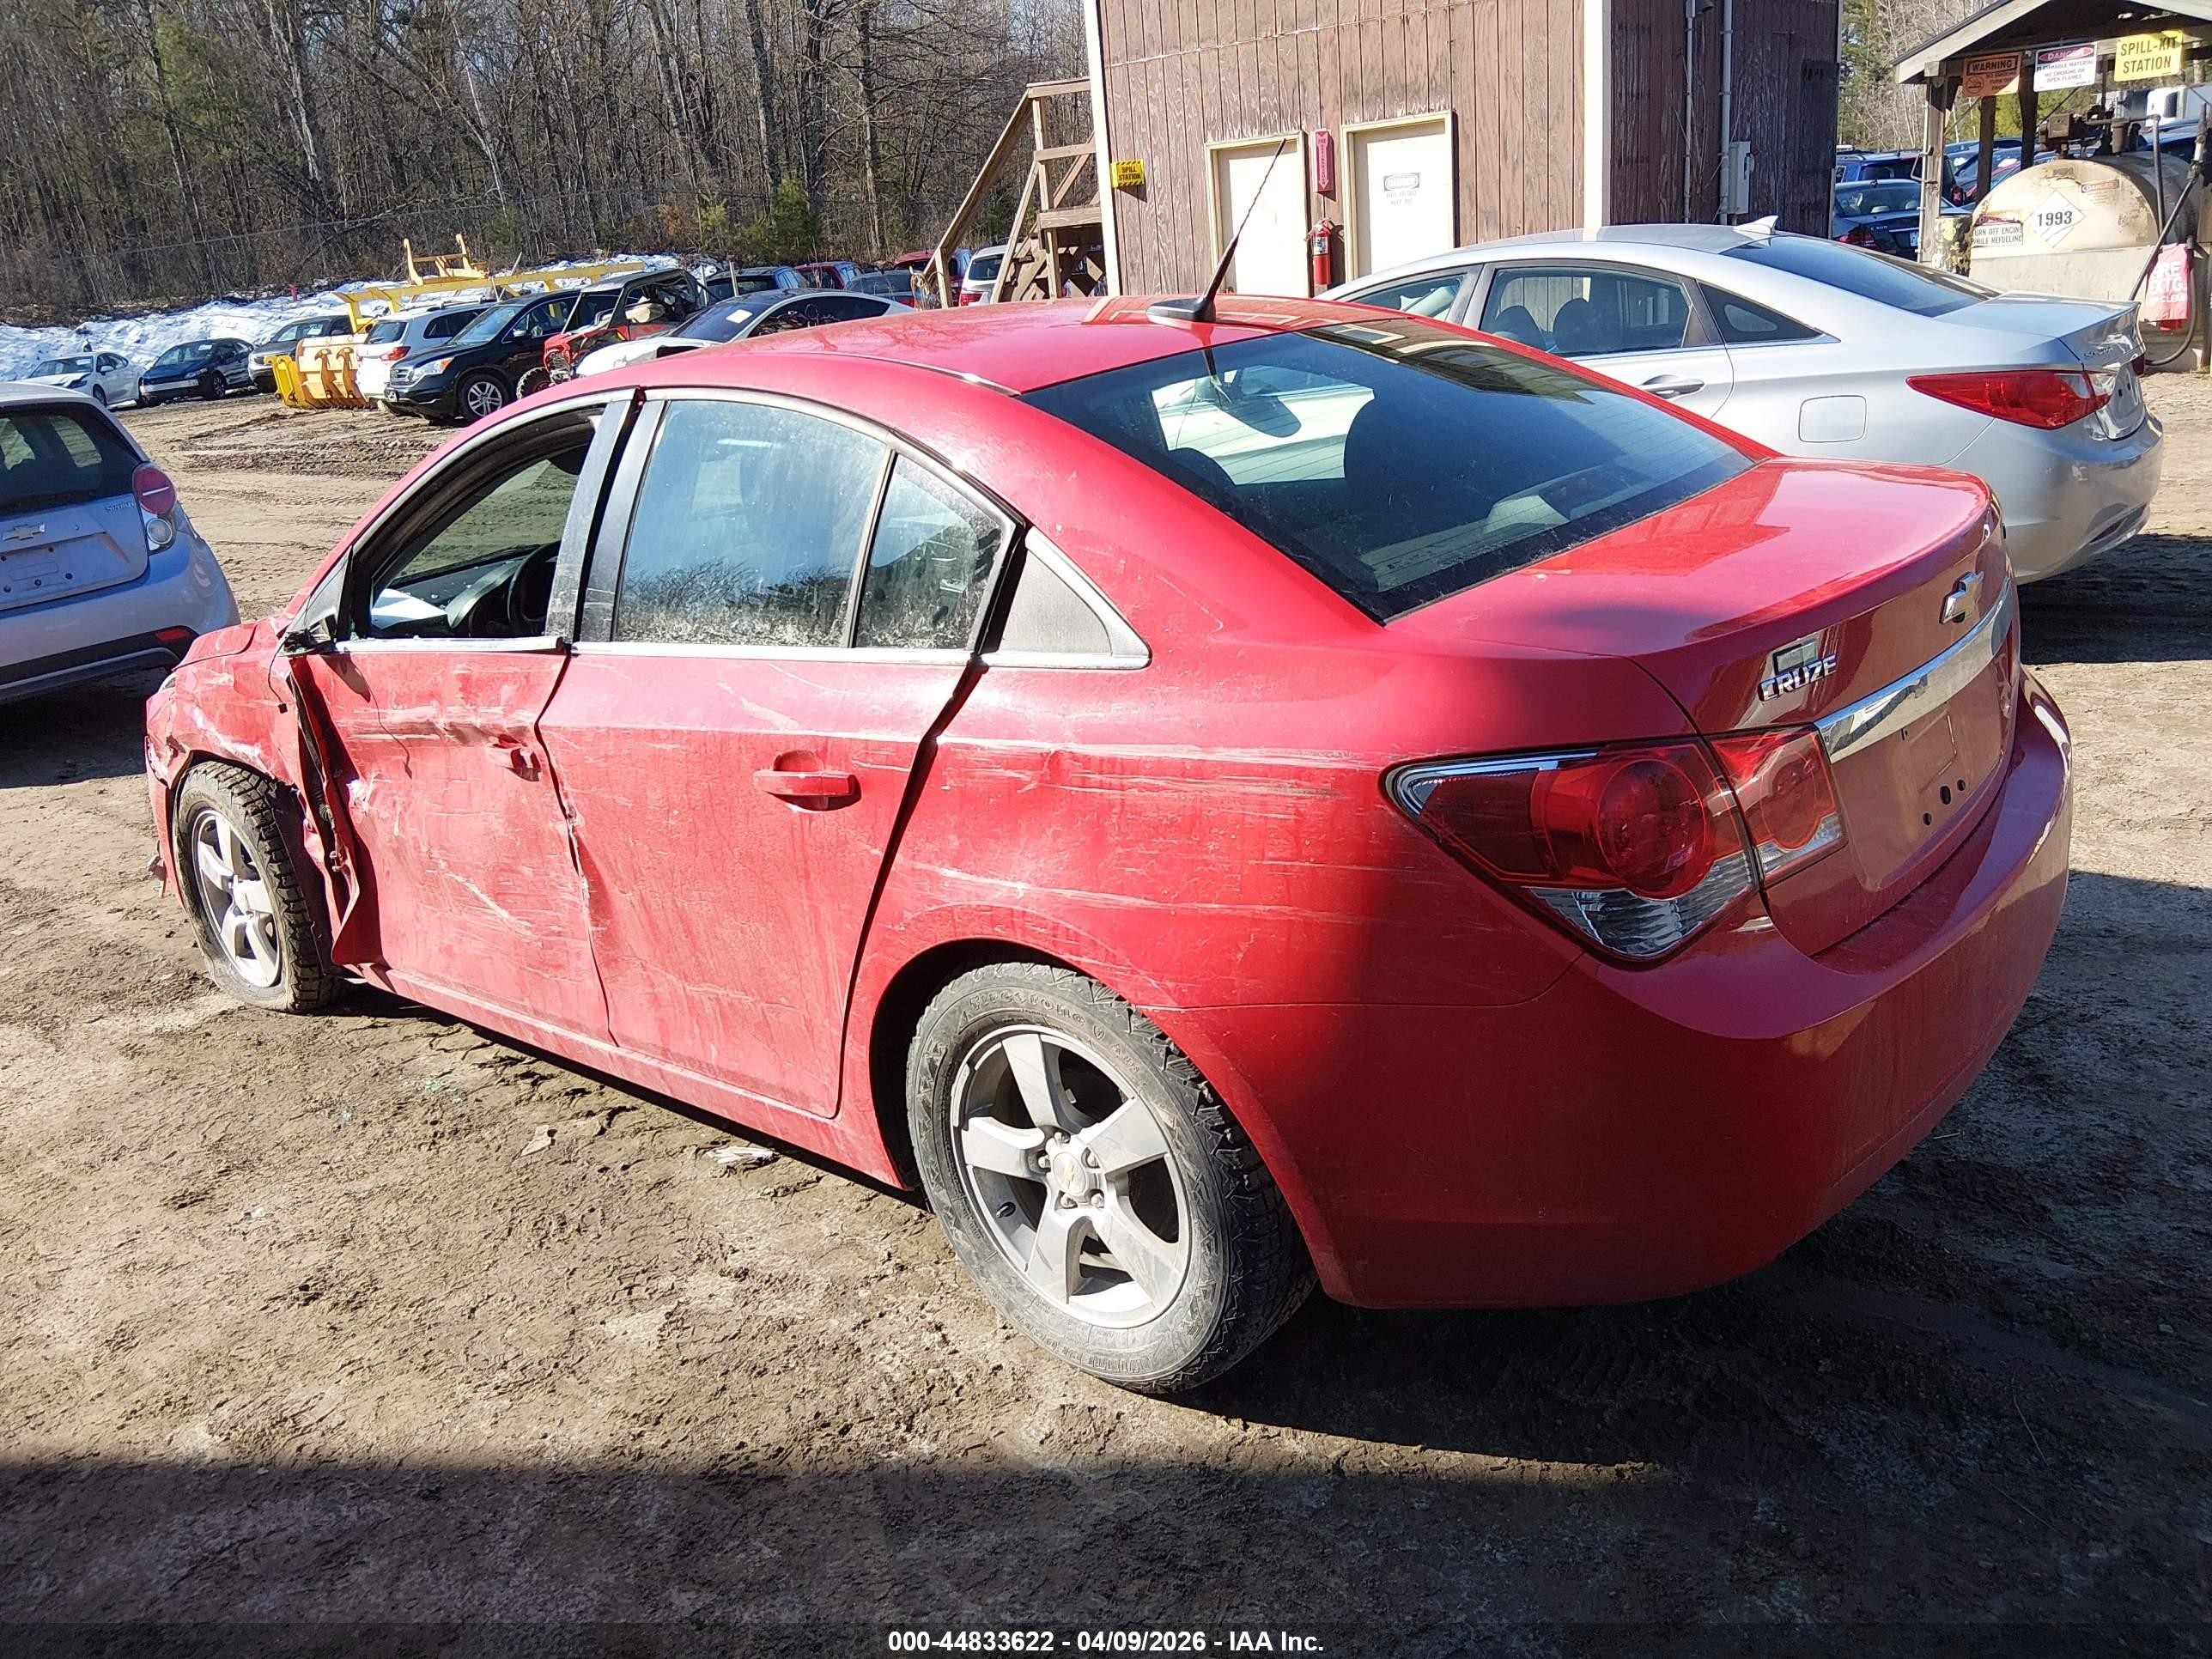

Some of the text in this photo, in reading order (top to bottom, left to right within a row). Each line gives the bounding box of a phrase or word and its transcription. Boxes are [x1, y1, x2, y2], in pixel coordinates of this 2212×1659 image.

[2120, 36, 2178, 57] SPILL-KIT
[1972, 60, 2012, 71] WARNING
[2123, 55, 2171, 74] STATION
[2037, 210, 2073, 228] 1993
[1973, 226, 2022, 237] URN OFF ENGINE
[1758, 653, 1837, 702] CRUZE
